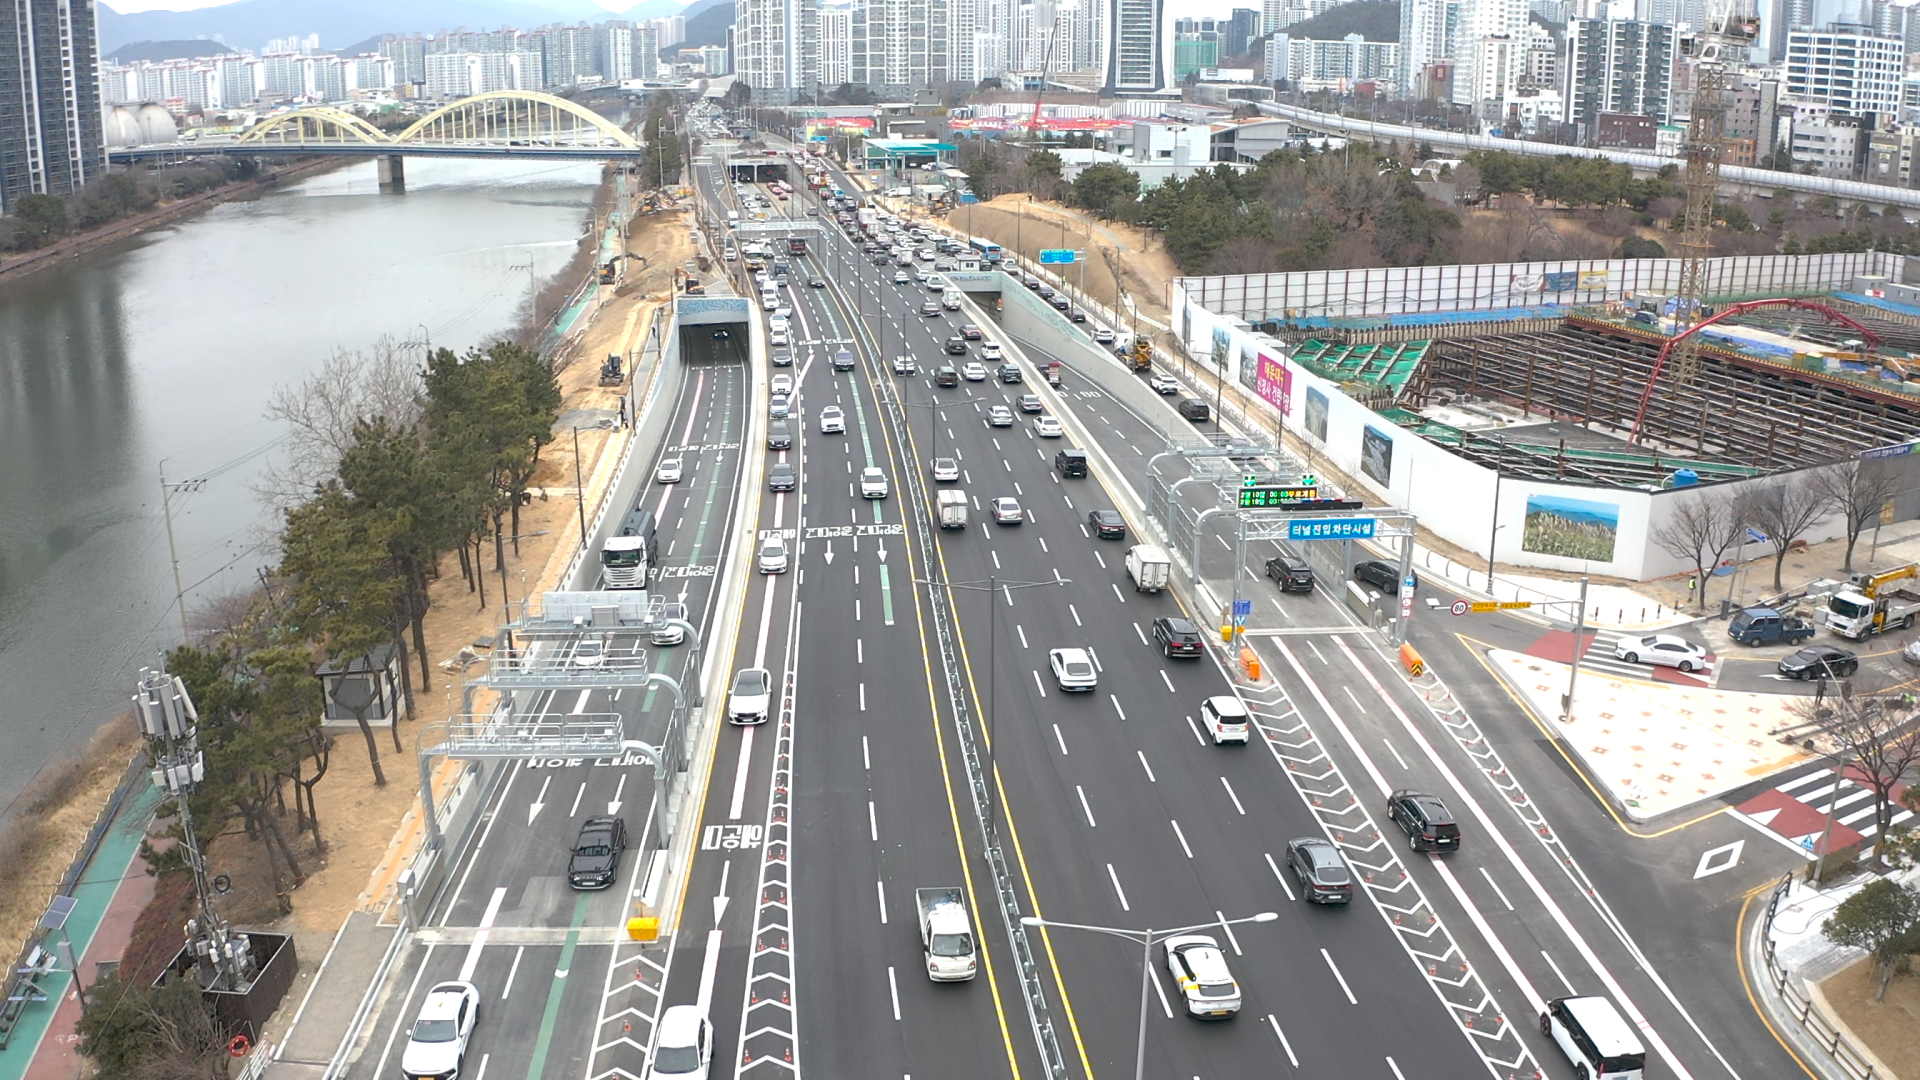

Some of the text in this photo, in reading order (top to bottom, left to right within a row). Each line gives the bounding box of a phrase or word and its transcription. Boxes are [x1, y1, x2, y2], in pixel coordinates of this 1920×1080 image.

[759, 528, 796, 540] 해운대
[805, 526, 853, 538] 광안대교
[855, 524, 904, 536] 광안대교
[1291, 523, 1371, 536] 터널진입차단시설
[664, 565, 715, 578] 광안대교
[701, 824, 763, 850] 해운대
